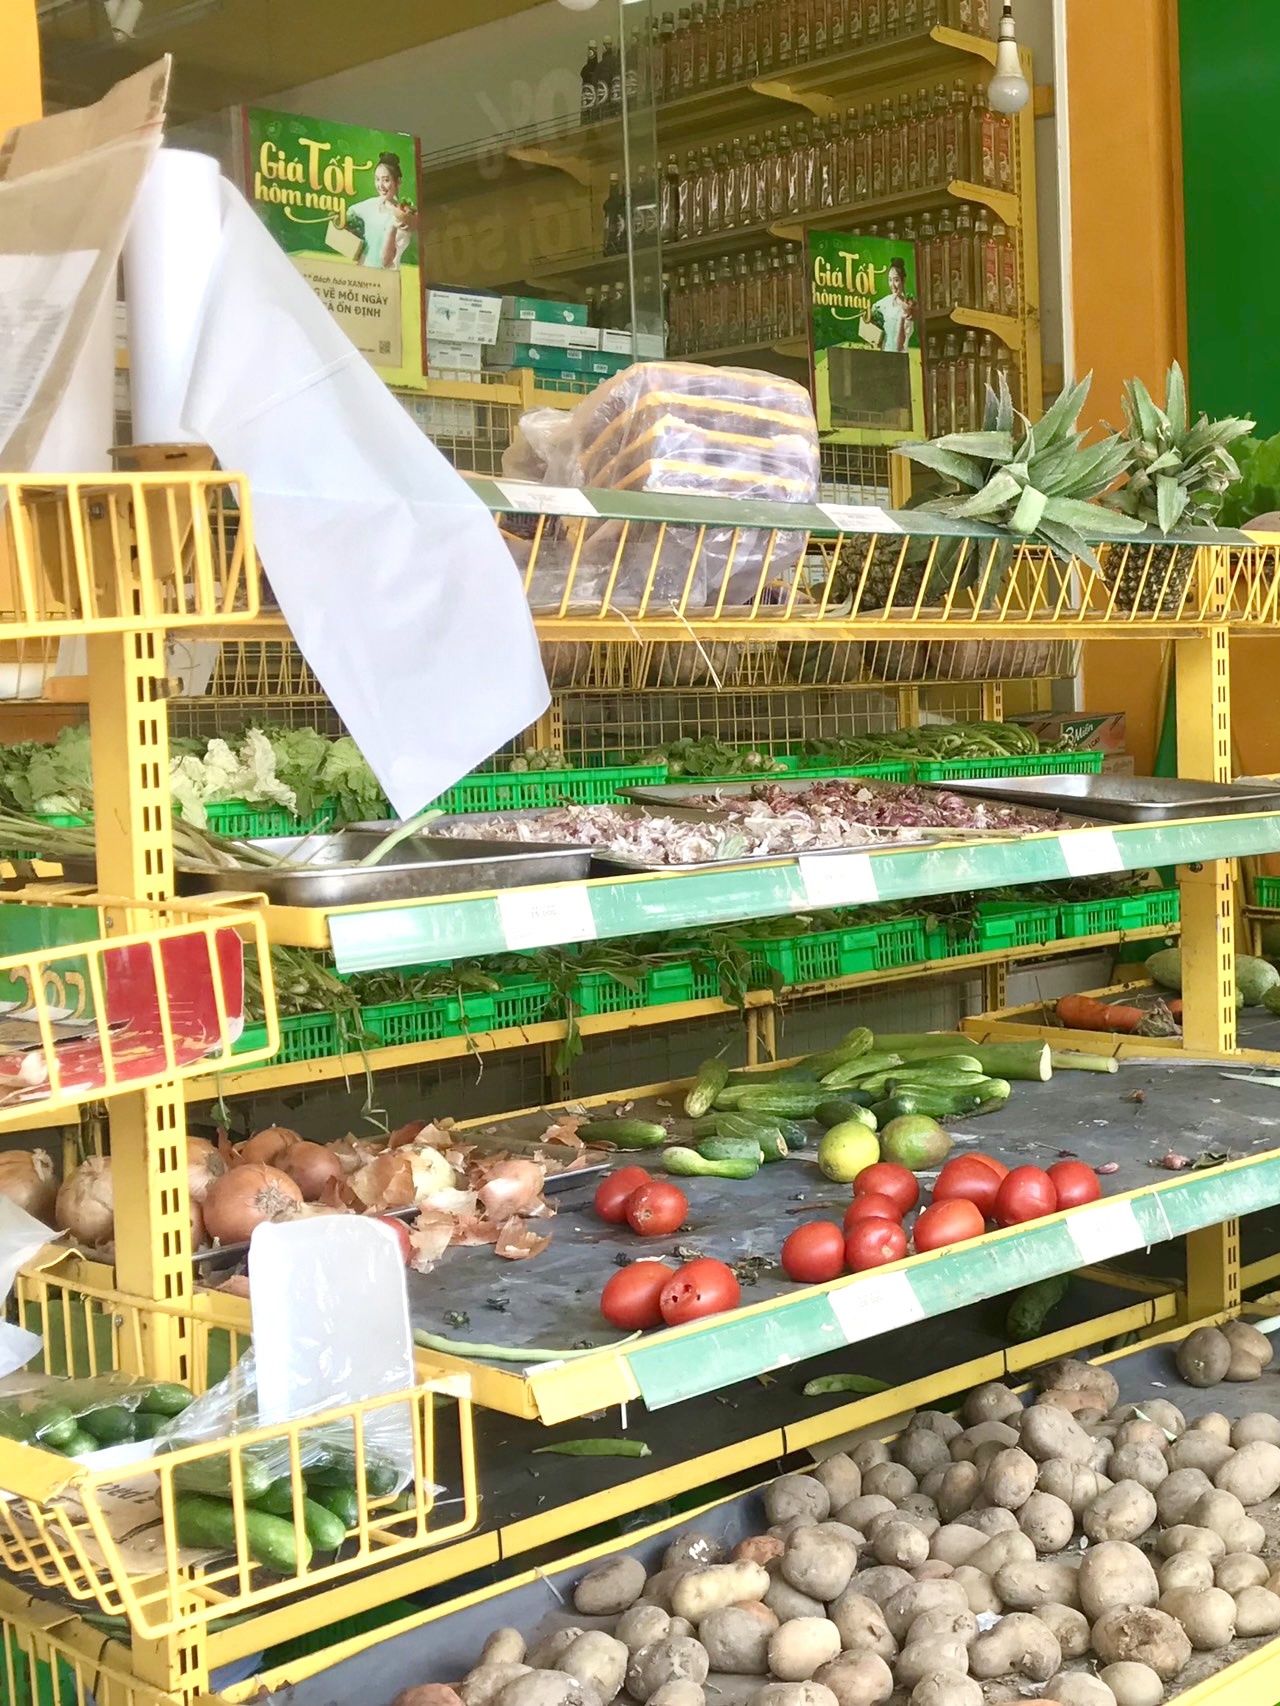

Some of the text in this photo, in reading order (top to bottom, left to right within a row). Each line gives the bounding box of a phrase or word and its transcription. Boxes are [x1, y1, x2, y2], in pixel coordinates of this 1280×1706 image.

[260, 137, 373, 196] Giá Tốt
[254, 171, 346, 230] hôm nay
[814, 251, 887, 295] Giá Tốt
[354, 306, 381, 318] ĐỊNH
[362, 292, 388, 305] NGÀY
[812, 281, 871, 324] hôm nay
